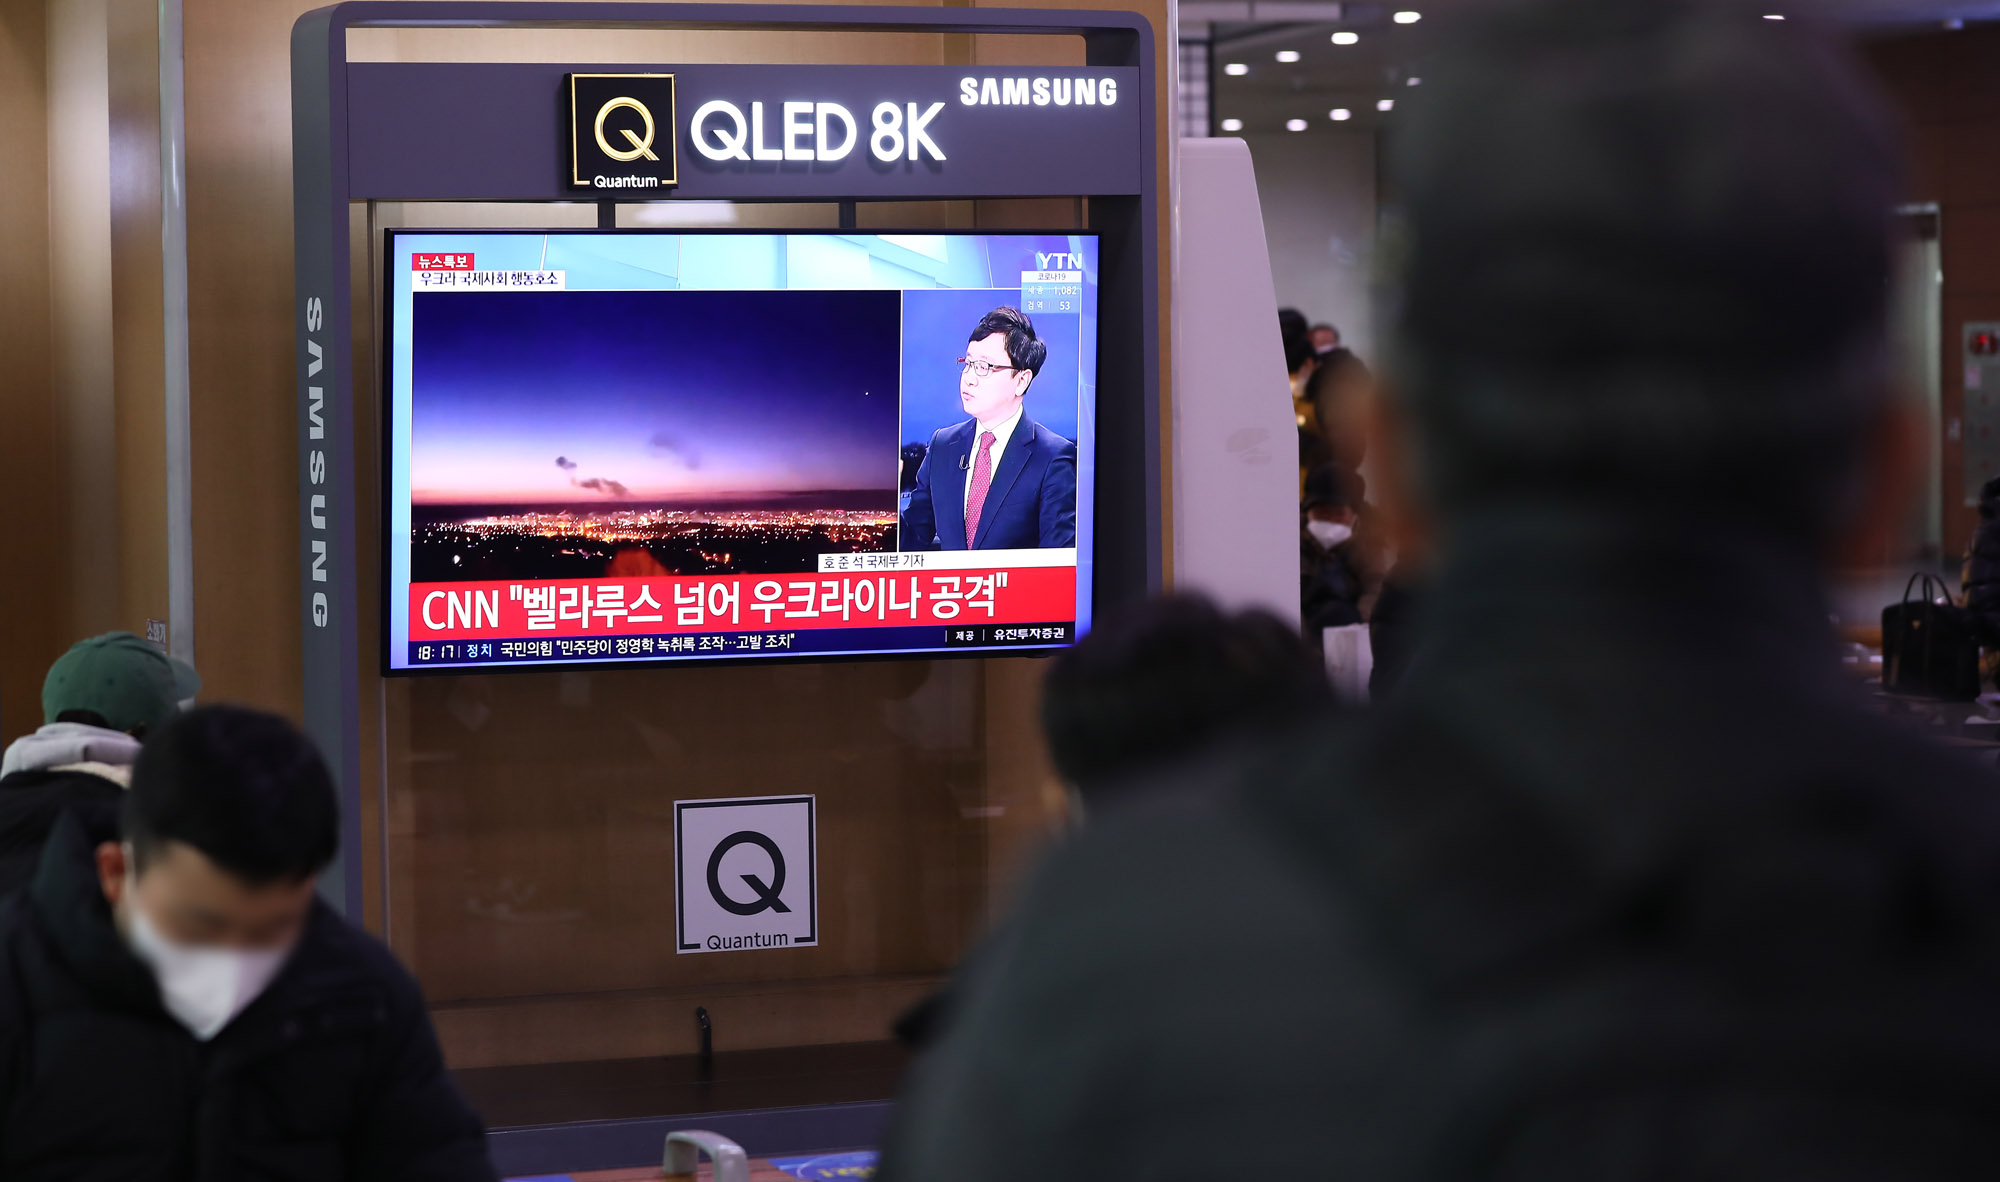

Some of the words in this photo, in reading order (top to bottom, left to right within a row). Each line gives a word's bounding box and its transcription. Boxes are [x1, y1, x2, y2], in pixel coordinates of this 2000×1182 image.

[959, 77, 1118, 106] SAMSUNG
[594, 96, 659, 162] Q
[690, 100, 858, 162] QLED
[870, 101, 947, 162] 8K
[594, 174, 658, 189] Quantum
[418, 255, 468, 268] 뉴스특보
[1038, 253, 1082, 270] YTN
[420, 272, 456, 286] 우크라
[460, 271, 508, 286] 국제사회
[511, 271, 559, 286] 행동호소
[1054, 286, 1077, 296] 1,082
[1059, 301, 1071, 310] 53
[306, 296, 328, 628] SAMSUNG
[867, 554, 899, 568] 국제부
[903, 554, 925, 567] 기자
[422, 589, 500, 631] CNN
[509, 584, 663, 632] "벨라루스
[673, 579, 741, 625] 넘어
[750, 577, 921, 624] 우크라이나
[929, 572, 1009, 619] 공격"
[955, 630, 975, 642] 제공
[993, 627, 1065, 641] 유진투자증권
[466, 643, 493, 658] 정치
[500, 641, 553, 657] 국민의힘
[615, 637, 655, 655] 정영학
[657, 636, 696, 653] 녹취록
[706, 830, 793, 916] Q
[706, 932, 789, 950] Quantum
